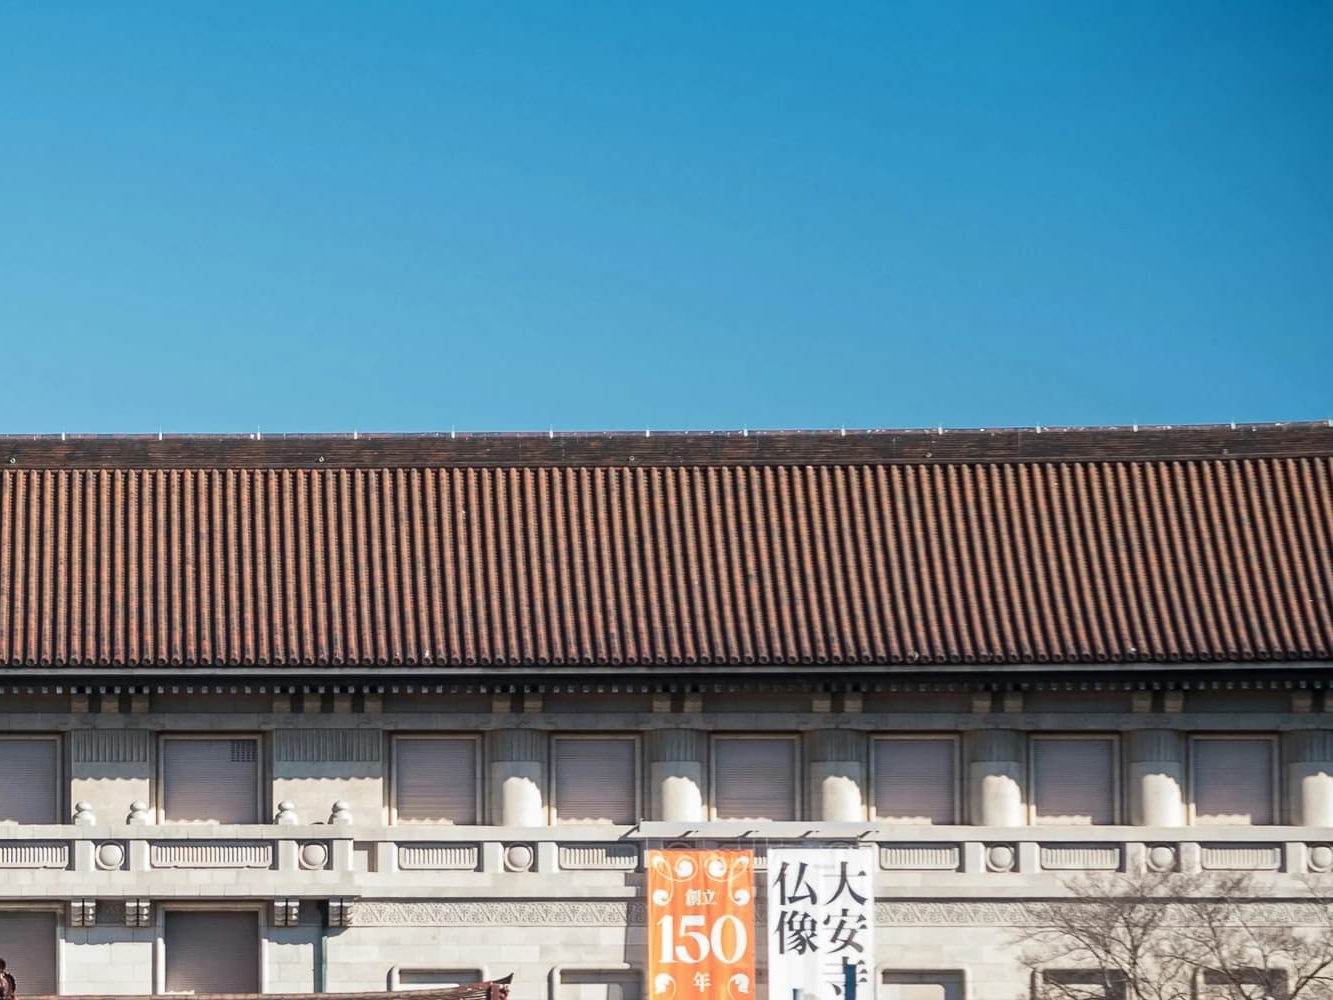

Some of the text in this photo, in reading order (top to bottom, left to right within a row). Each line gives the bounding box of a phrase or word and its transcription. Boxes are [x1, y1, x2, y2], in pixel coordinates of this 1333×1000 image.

[685, 888, 717, 907] 創立
[771, 860, 819, 956] 仏像
[656, 913, 747, 965] 150
[822, 860, 869, 997] 大安寺
[693, 971, 713, 994] 年
